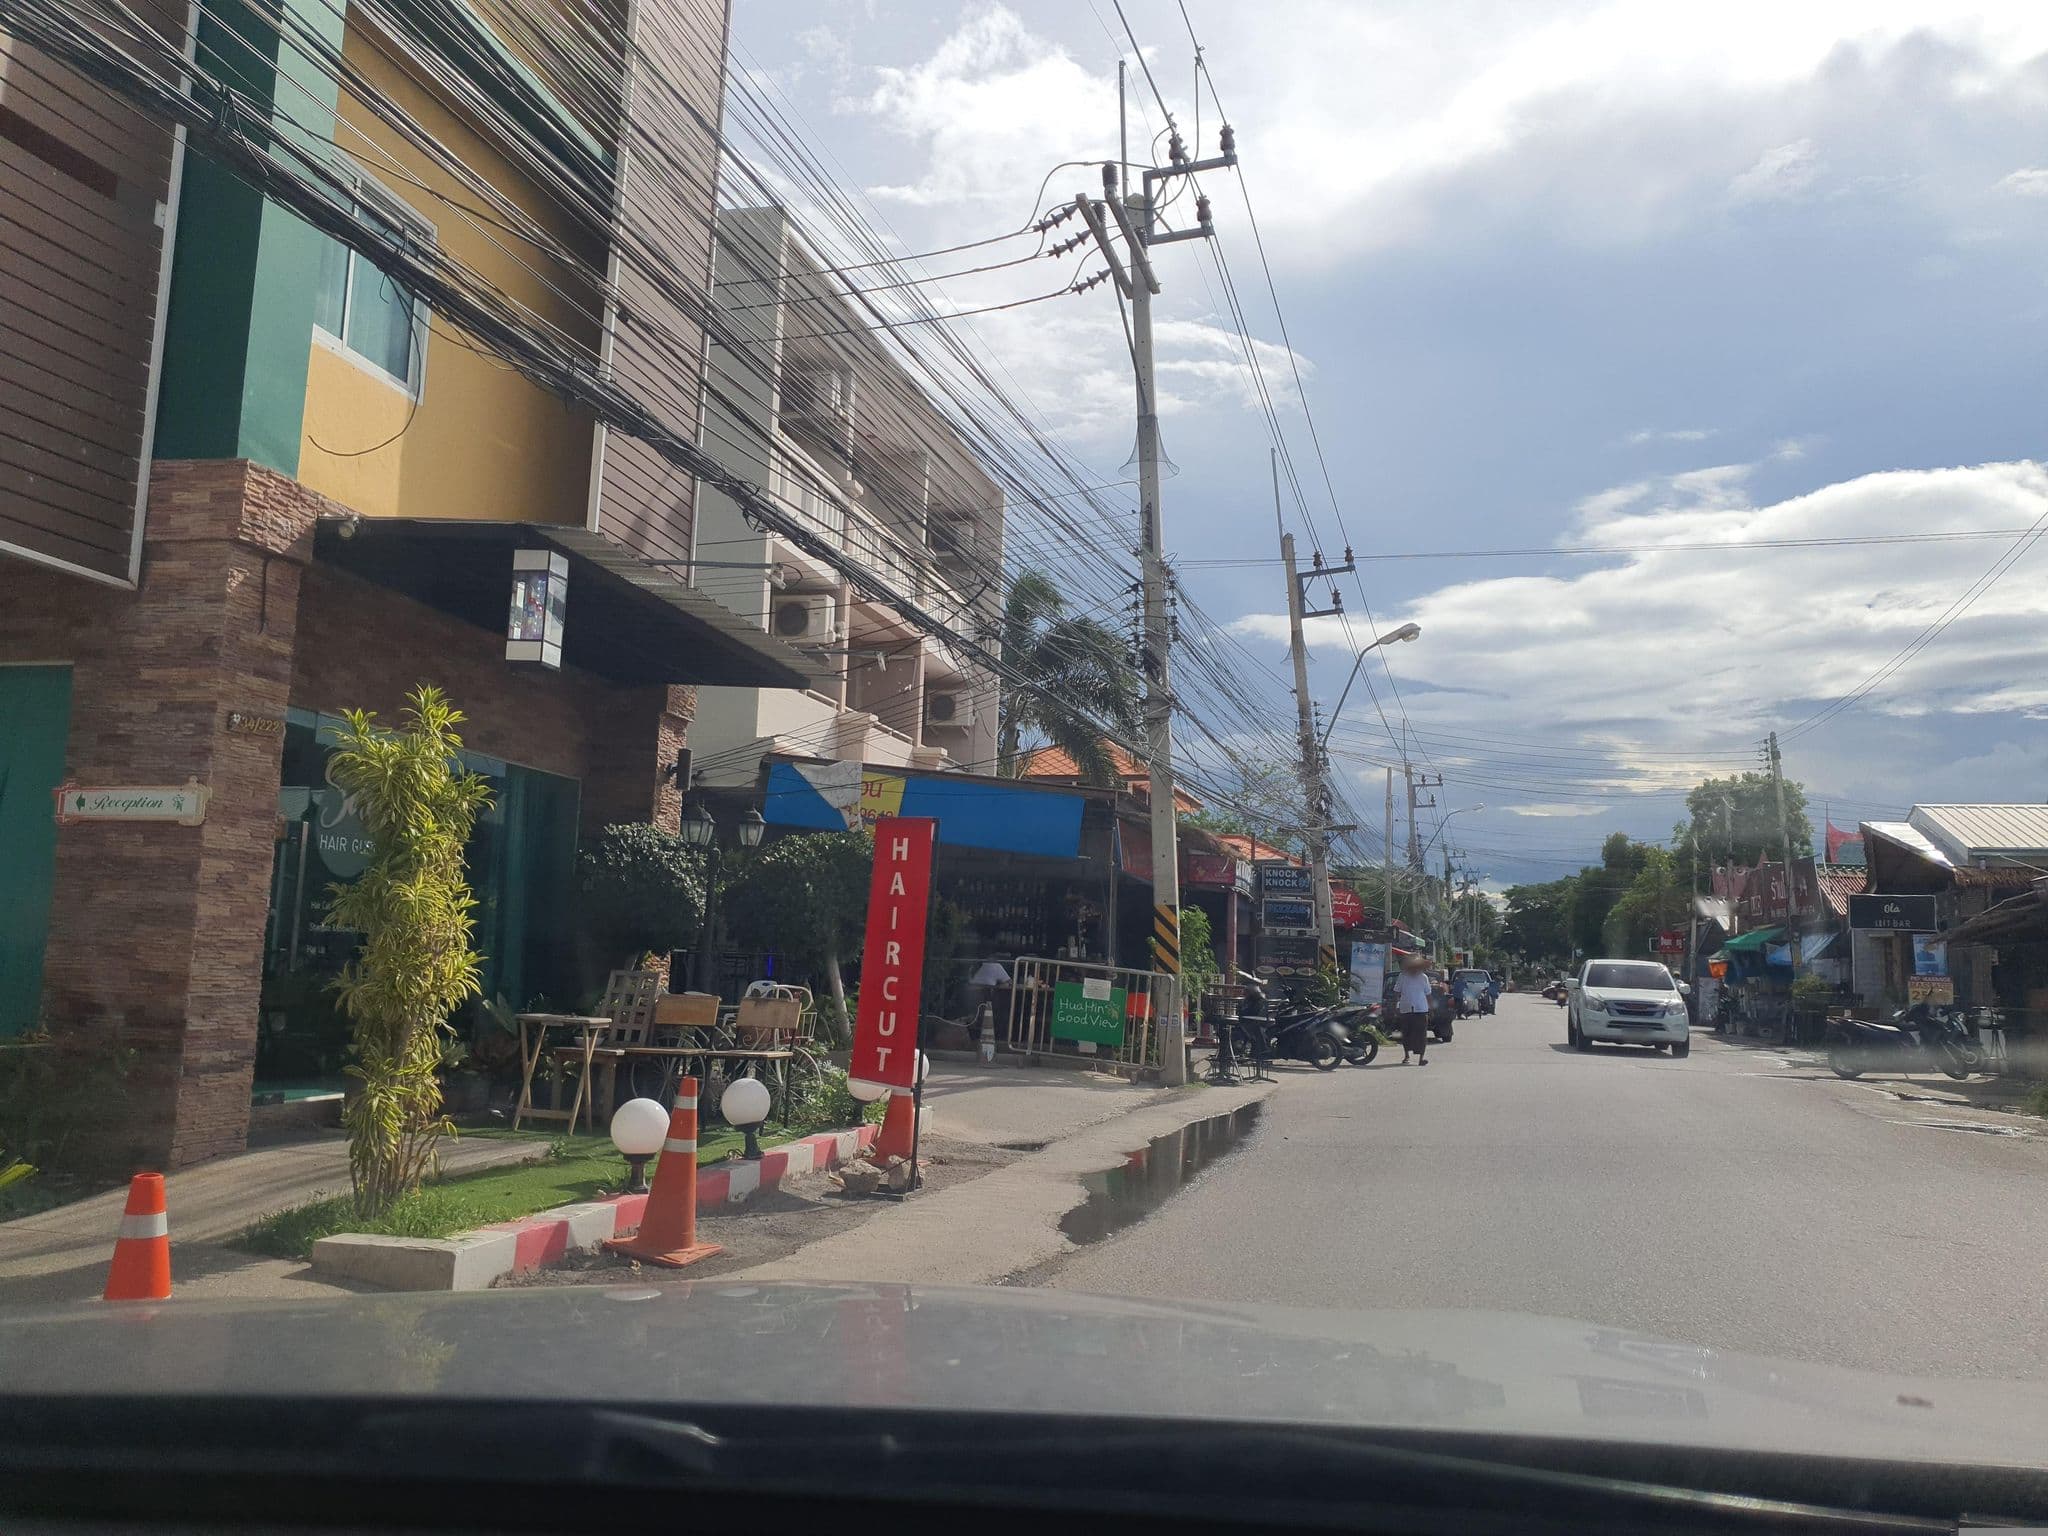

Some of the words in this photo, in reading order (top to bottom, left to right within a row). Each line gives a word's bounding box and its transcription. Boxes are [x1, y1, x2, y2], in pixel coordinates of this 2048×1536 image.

[89, 794, 164, 812] Reception
[319, 834, 348, 853] HAIR
[1265, 869, 1298, 878] KNOCK
[1265, 878, 1298, 887] KNOCK
[875, 837, 910, 1073] HAIRCUT
[1060, 998, 1084, 1011] Hua
[1057, 1011, 1089, 1025] Good
[1089, 1014, 1119, 1029] View
